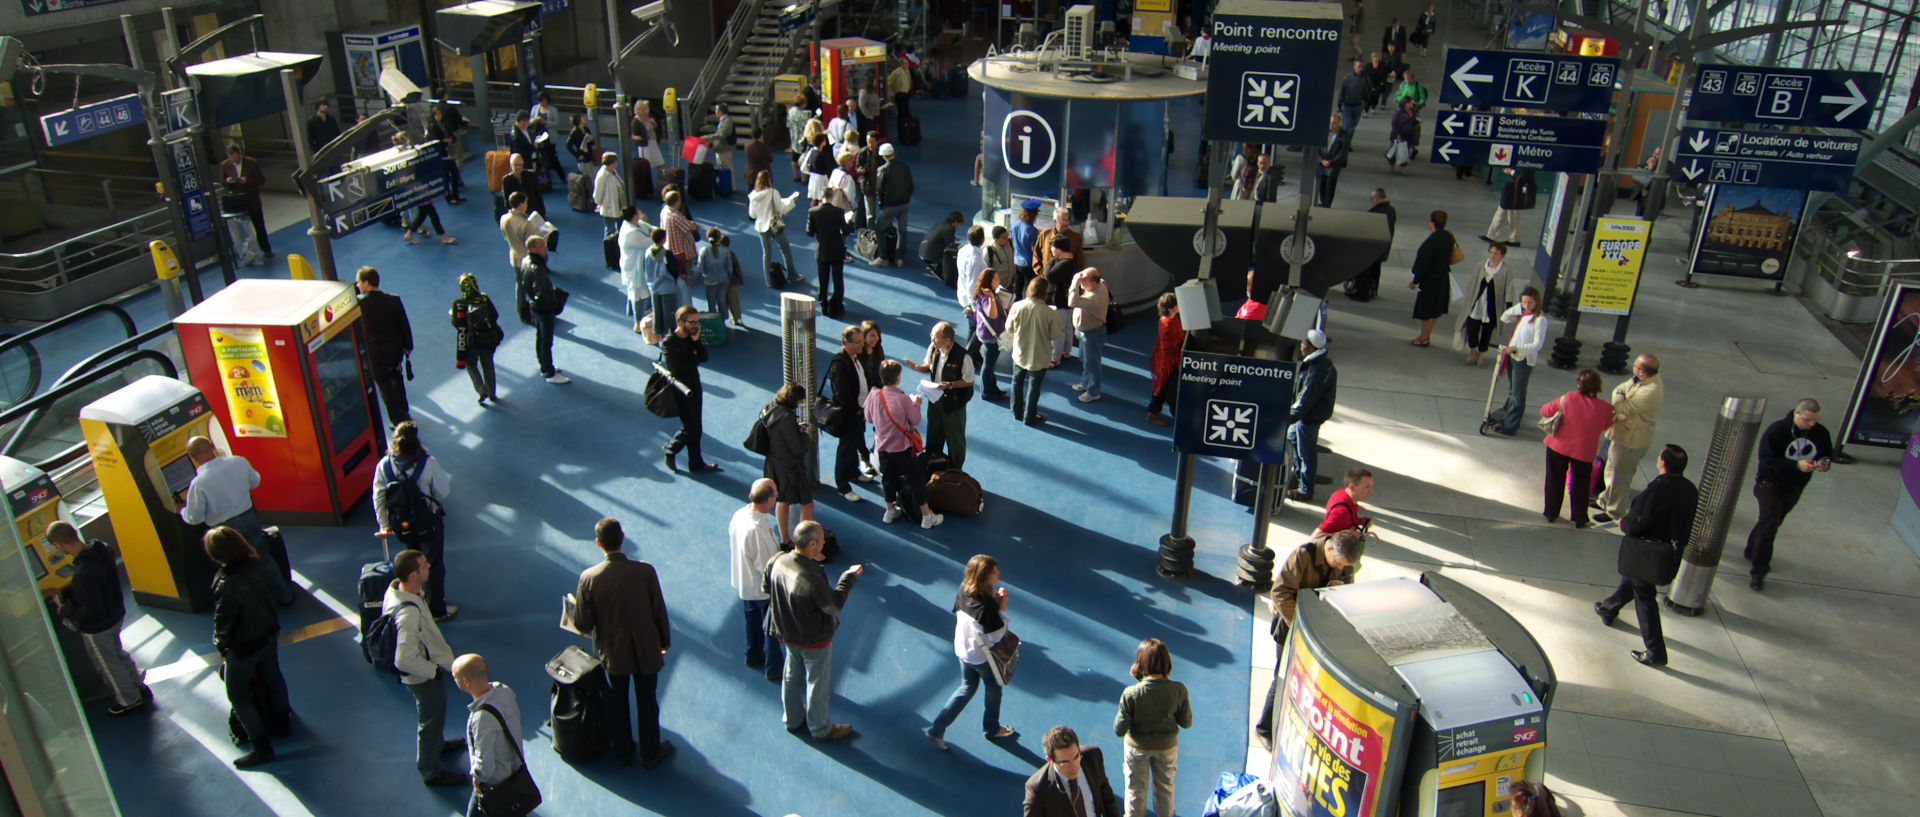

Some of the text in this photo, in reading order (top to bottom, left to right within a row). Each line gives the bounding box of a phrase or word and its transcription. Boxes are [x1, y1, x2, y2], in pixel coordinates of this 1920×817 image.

[1214, 21, 1339, 41] Point rencontre
[1213, 42, 1281, 54] Meeting point
[1516, 61, 1546, 72] Accès
[1559, 70, 1611, 85] 44 46
[1771, 77, 1803, 88] Accès
[1516, 75, 1537, 98] K
[1703, 79, 1756, 94] 43 45
[1770, 90, 1793, 114] B
[99, 109, 129, 125] 44 46
[175, 104, 191, 127] K
[1499, 117, 1527, 126] Sortie
[1497, 126, 1529, 135] Boulevard
[1528, 134, 1557, 142] Corbusier
[1743, 134, 1858, 151] Location de voitures
[1517, 145, 1553, 158] Métro
[1754, 149, 1778, 157] rentals
[1787, 150, 1804, 158] Auto
[1805, 152, 1833, 160] verhuur
[179, 156, 192, 169] 44
[383, 159, 408, 175] Sortie
[1714, 168, 1726, 180] A
[1742, 170, 1750, 182] L
[184, 176, 198, 190] 46
[1599, 240, 1642, 251] EUROPE
[1604, 250, 1625, 260] XXL
[1182, 356, 1293, 380] Point rencontre
[1181, 373, 1242, 386] Meeting point
[31, 488, 48, 504] SNCF
[1300, 684, 1364, 766] Point
[1334, 709, 1368, 738] révolution
[1455, 730, 1476, 740] achat
[1513, 730, 1536, 743] SNCF
[1455, 737, 1479, 748] retrait
[1456, 744, 1487, 756] échange
[1318, 744, 1333, 765] vie
[1331, 757, 1351, 781] des
